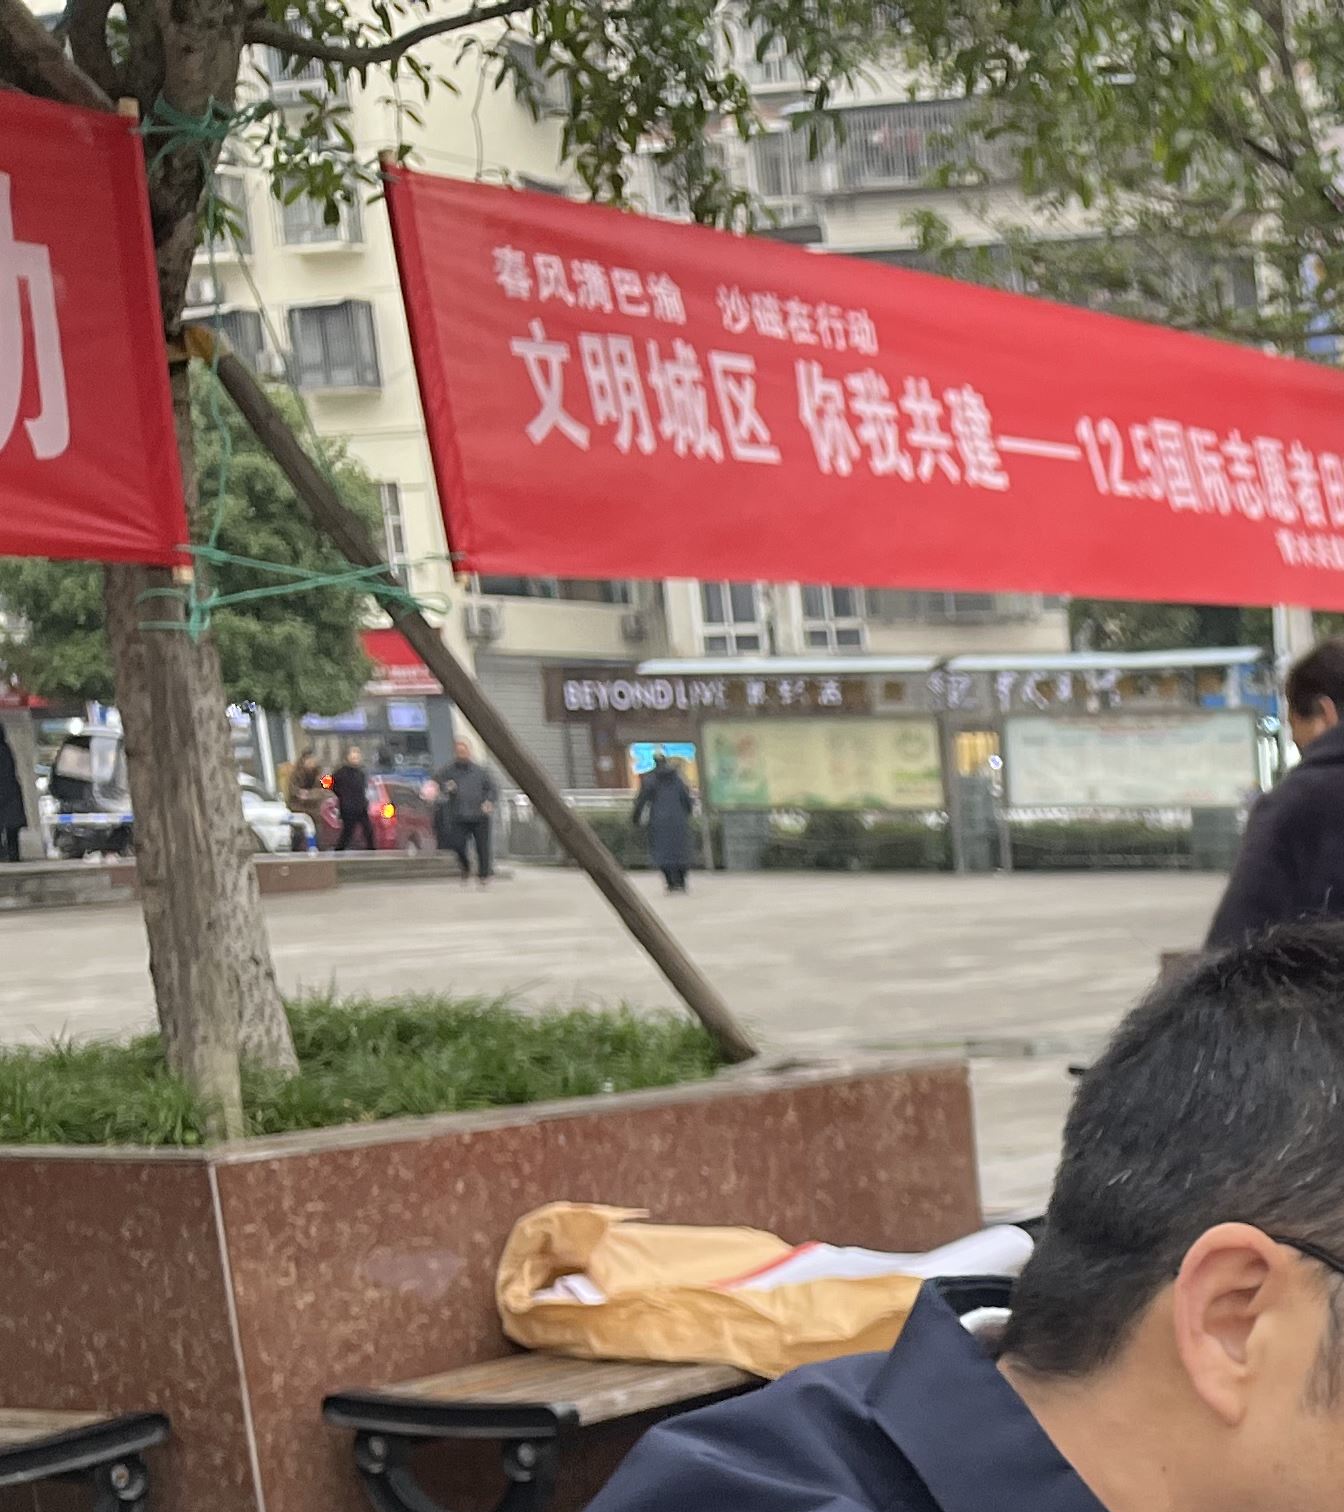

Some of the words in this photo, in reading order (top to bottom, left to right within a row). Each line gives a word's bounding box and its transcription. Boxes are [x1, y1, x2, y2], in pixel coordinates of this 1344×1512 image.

[492, 244, 687, 325] 春风满巴渝
[510, 317, 783, 466] 文明城区
[563, 679, 673, 711] BEYOND
